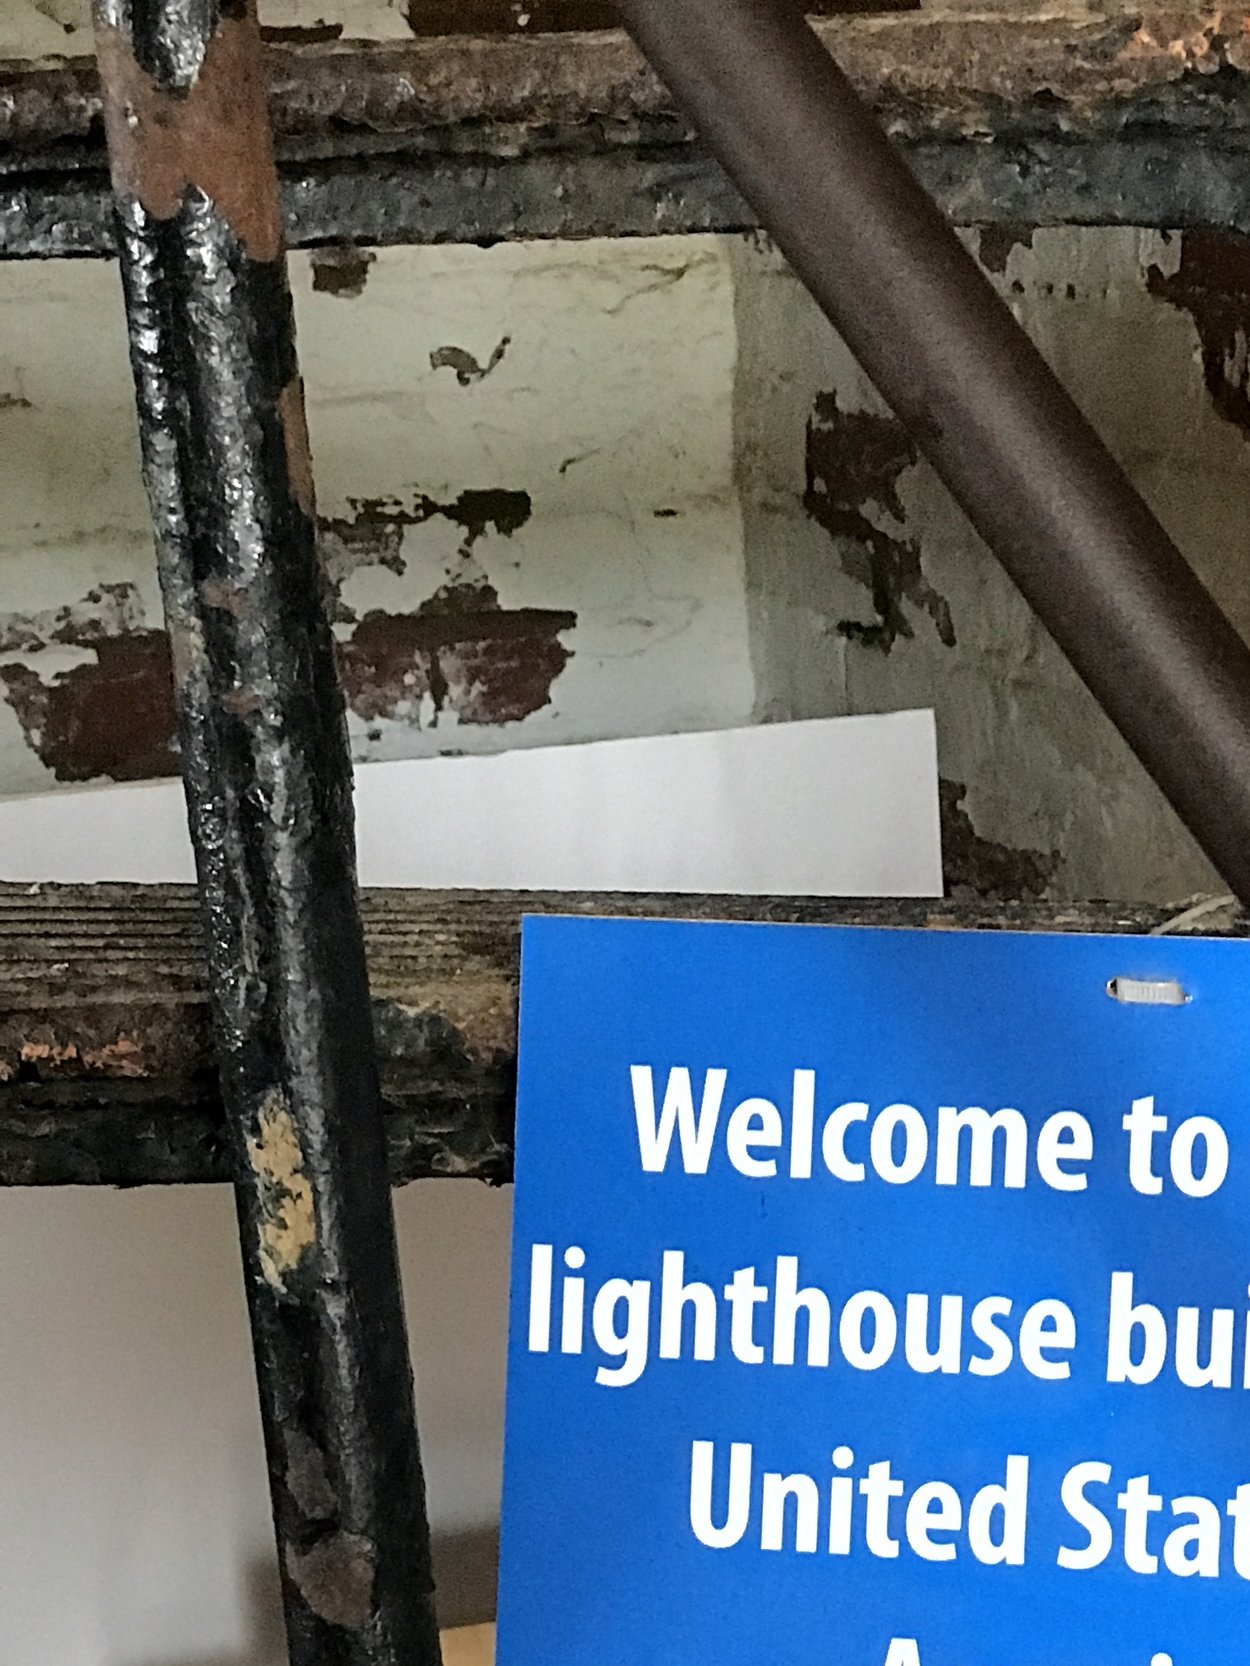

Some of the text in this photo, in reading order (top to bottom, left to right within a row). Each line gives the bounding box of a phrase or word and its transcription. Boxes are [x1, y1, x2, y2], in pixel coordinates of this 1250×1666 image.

[630, 1064, 1094, 1192] Welcome
[1122, 1095, 1229, 1198] to
[528, 1243, 1076, 1388] lighthouse
[689, 1440, 1029, 1566] United
